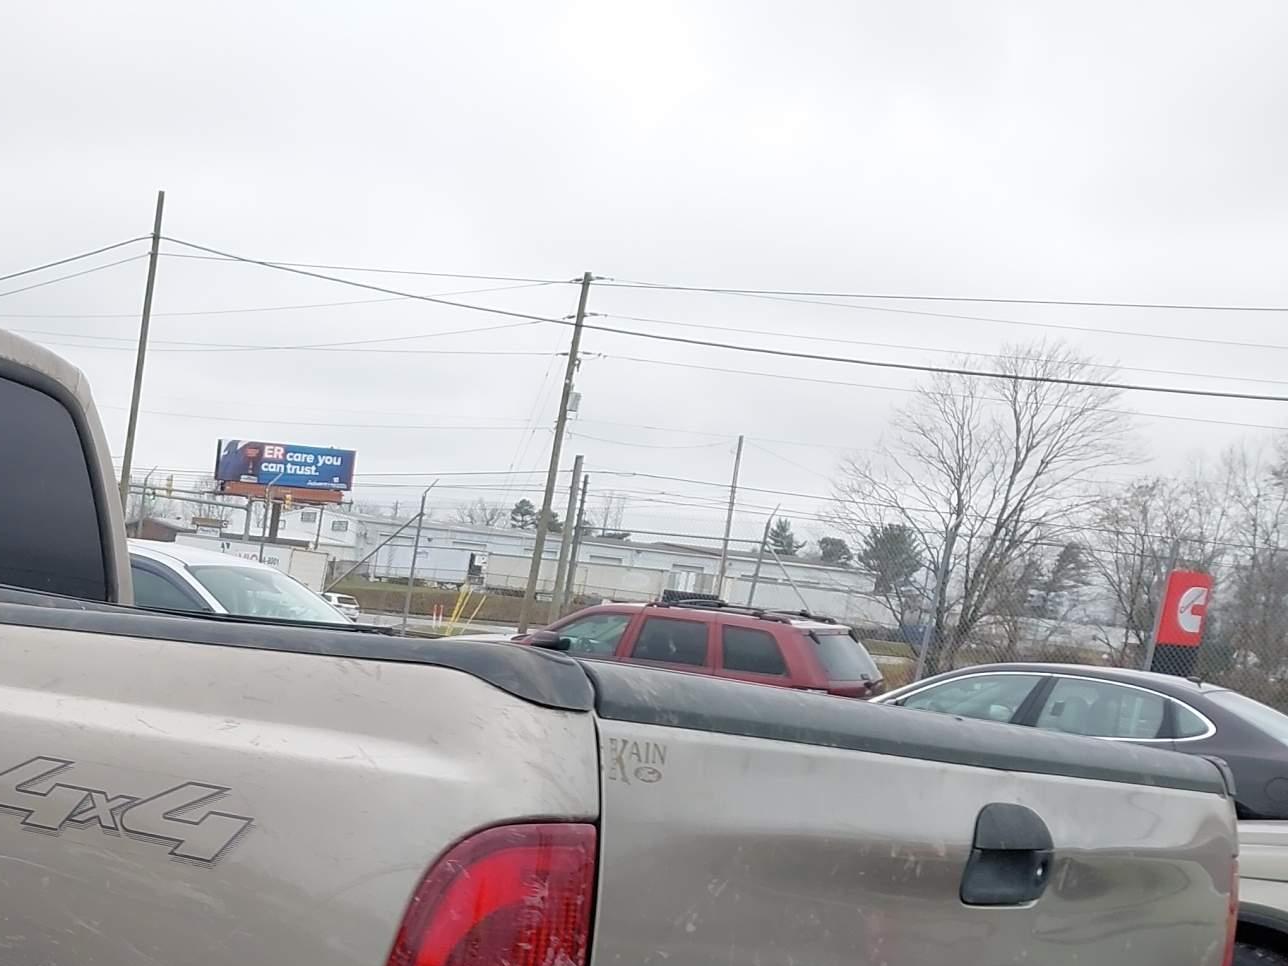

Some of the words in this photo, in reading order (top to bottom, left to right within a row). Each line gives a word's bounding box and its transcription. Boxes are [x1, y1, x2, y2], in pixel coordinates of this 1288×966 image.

[263, 445, 284, 459] ER
[286, 451, 314, 463] care
[317, 454, 342, 466] you
[261, 462, 284, 473] can
[286, 463, 319, 475] trust.
